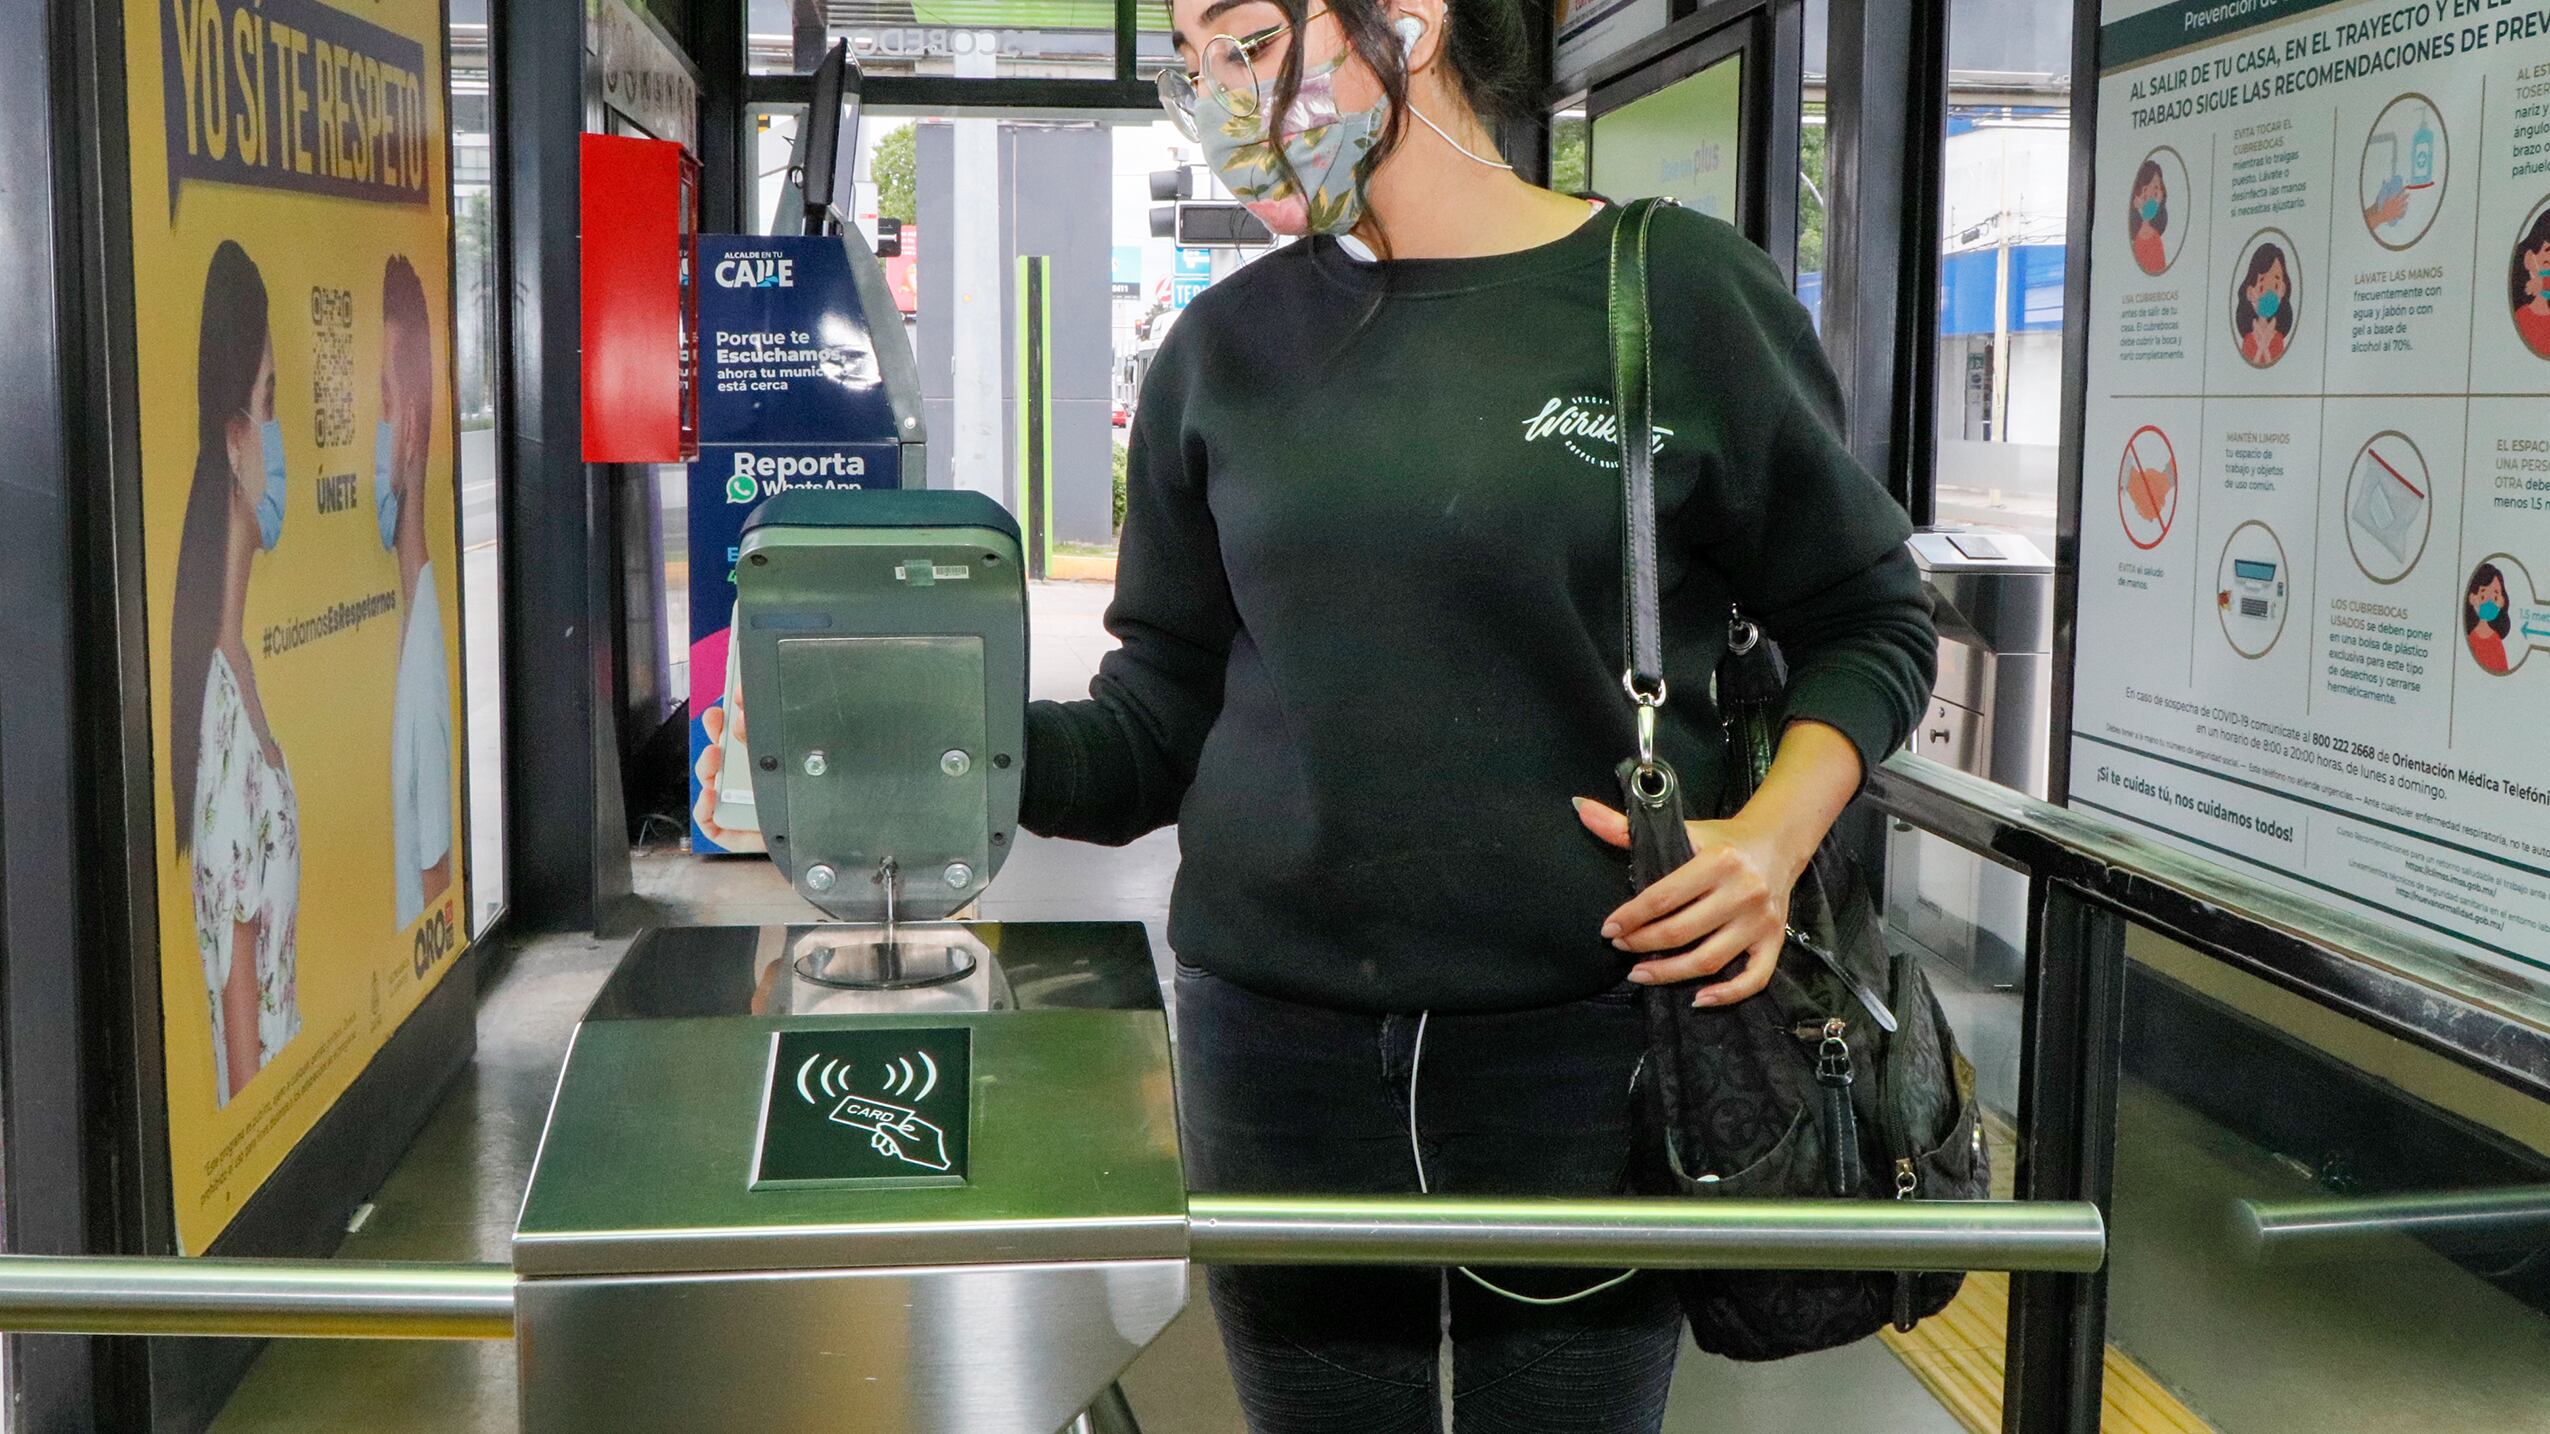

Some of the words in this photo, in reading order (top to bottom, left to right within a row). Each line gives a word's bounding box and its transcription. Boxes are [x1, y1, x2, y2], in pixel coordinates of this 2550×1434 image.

[2130, 82, 2146, 102] AL
[2150, 69, 2187, 96] SALIR
[2191, 63, 2210, 85] DE
[2214, 57, 2232, 79] TU
[2236, 46, 2281, 73] CASA,
[2286, 36, 2307, 61] EN
[2312, 31, 2331, 54] EL
[2336, 3, 2430, 48] TRAYECTO
[2435, 0, 2448, 21] Y
[2454, 0, 2479, 17] EN
[2131, 98, 2192, 130] TRABAJO
[2197, 86, 2238, 115] SIGUE
[2242, 78, 2270, 105] LAS
[2274, 32, 2454, 97] RECOMENDACIONES
[2461, 24, 2489, 52] DE
[2495, 10, 2550, 45] PREV
[2517, 67, 2530, 81] AL
[174, 0, 227, 161] YO
[233, 0, 268, 166] SÍ
[270, 21, 313, 175] TE
[315, 38, 422, 191] RESPETO
[2515, 103, 2540, 119] nariz
[2542, 104, 2550, 117] y
[2513, 121, 2550, 139] ángulo
[2512, 143, 2542, 157] brazo
[724, 251, 760, 259] ALCALDE
[761, 251, 772, 259] EN
[773, 251, 783, 259] TU
[715, 260, 794, 288] CALLE
[2389, 269, 2407, 282] LAS
[2408, 266, 2443, 280] MANOS
[2353, 287, 2423, 302] frecuentemente
[2425, 286, 2442, 297] con
[2353, 308, 2373, 321] agua
[2375, 309, 2380, 320] y
[2382, 304, 2407, 319] jabón
[2409, 306, 2415, 315] o
[2416, 305, 2433, 315] con
[2352, 324, 2365, 338] gel
[2367, 325, 2372, 334] a
[2374, 323, 2394, 334] base
[2396, 322, 2407, 333] de
[716, 331, 786, 348] Porque
[790, 331, 810, 345] te
[2352, 340, 2381, 353] alcohol
[2383, 341, 2390, 352] al
[717, 348, 847, 364] Escuchamos,
[717, 368, 757, 379] ahora
[760, 367, 776, 378] tu
[718, 380, 746, 391] está
[751, 381, 788, 391] cerca
[2235, 448, 2262, 460] espacio
[2263, 449, 2272, 459] de
[2497, 439, 2509, 451] EL
[734, 452, 865, 484] Reporta
[2496, 457, 2518, 470] UNA
[316, 463, 357, 515] ÚNETE
[2494, 476, 2523, 489] OTRA
[2494, 497, 2528, 508] menos
[2331, 599, 2348, 610] LOS
[2349, 601, 2408, 620] CUBREBOCAS
[2330, 615, 2365, 630] USADOS
[2366, 622, 2376, 632] se
[2378, 621, 2404, 636] deben
[2406, 628, 2432, 641] poner
[2329, 632, 2340, 642] en
[2341, 635, 2357, 646] una
[2358, 637, 2380, 650] bolsa
[2382, 641, 2393, 652] de
[2394, 642, 2428, 658] plástico
[2328, 649, 2364, 664] exclusiva
[2366, 656, 2385, 669] para
[2386, 660, 2404, 671] este
[2406, 660, 2423, 676] tipo
[2328, 664, 2338, 675] de
[2340, 666, 2378, 684] desechos
[2379, 676, 2384, 688] y
[2386, 677, 2421, 692] cerrarse
[2327, 680, 2397, 705] herméticamente.
[2125, 686, 2136, 699] En
[2137, 691, 2153, 704] caso
[2153, 694, 2163, 706] de
[2164, 698, 2199, 716] sospecha
[2200, 705, 2211, 718] de
[2212, 708, 2249, 728] COVID-19
[2302, 730, 2311, 743] al
[2312, 732, 2331, 749] 800
[2332, 738, 2350, 754] 222
[2351, 742, 2375, 760] 2668
[2377, 749, 2390, 764] de
[2392, 752, 2455, 781] Orientación
[2458, 768, 2500, 792] Médica
[2196, 724, 2207, 734] en
[2208, 727, 2218, 738] un
[2220, 729, 2249, 747] horario
[2250, 737, 2261, 750] de
[2263, 739, 2282, 755] 8:00
[2283, 746, 2289, 757] a
[2290, 746, 2315, 764] 20:00
[2316, 752, 2344, 773] horas,
[2345, 761, 2359, 776] de
[2360, 764, 2387, 784] lunes
[2389, 775, 2395, 786] a
[2397, 775, 2447, 801] domingo.
[2111, 771, 2121, 786] te
[2123, 775, 2156, 797] cuidas
[2158, 786, 2172, 806] tú,
[2175, 792, 2194, 811] nos
[2197, 799, 2252, 830] cuidamos
[2255, 816, 2293, 843] todos!
[2415, 811, 2460, 832] enfermedad
[2462, 825, 2508, 847] respiratoria,
[2509, 839, 2520, 849] no
[2521, 842, 2530, 853] te
[415, 909, 445, 980] QRO
[847, 1104, 895, 1123] CARD
